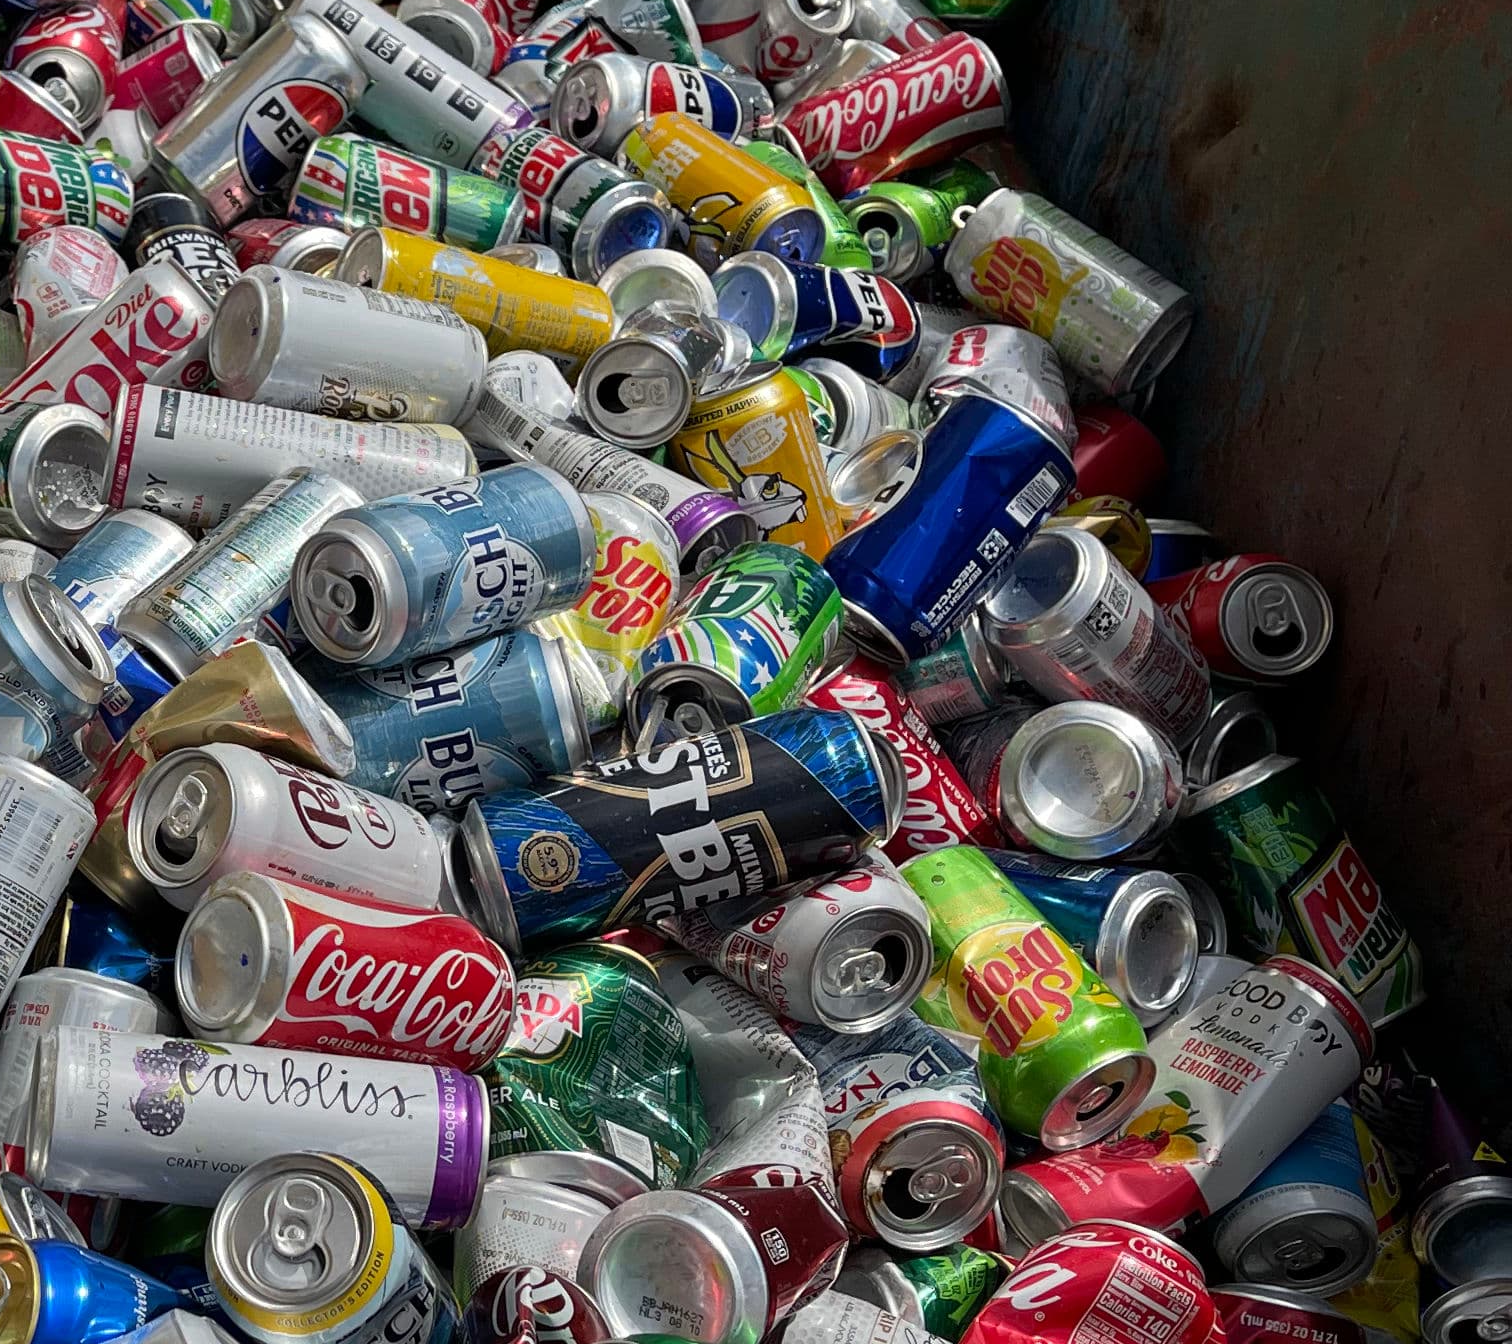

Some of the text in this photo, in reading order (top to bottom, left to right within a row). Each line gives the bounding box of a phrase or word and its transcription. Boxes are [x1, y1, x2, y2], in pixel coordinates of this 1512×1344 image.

[104, 284, 154, 329] Diet
[597, 536, 673, 612] Sun
[288, 923, 512, 1057] Coca-Cola
[961, 926, 1067, 1022] Drop
[987, 969, 1074, 1058] Sun
[317, 1035, 388, 1053] ORIGINAL
[1182, 1037, 1268, 1084] RASPBERRY
[1190, 1015, 1290, 1072] Lemonade
[94, 1060, 113, 1131] COCKTAIL
[521, 1090, 561, 1111] ALE
[1169, 1056, 1249, 1096] LEMONADE
[441, 1087, 457, 1166] Raspberry
[166, 1155, 252, 1176] CRAFT VODK
[275, 1248, 386, 1331] COLLECTOR'S EDITION
[1119, 1257, 1195, 1305] Nutrition Facts
[1099, 1292, 1169, 1339] Calories 140
